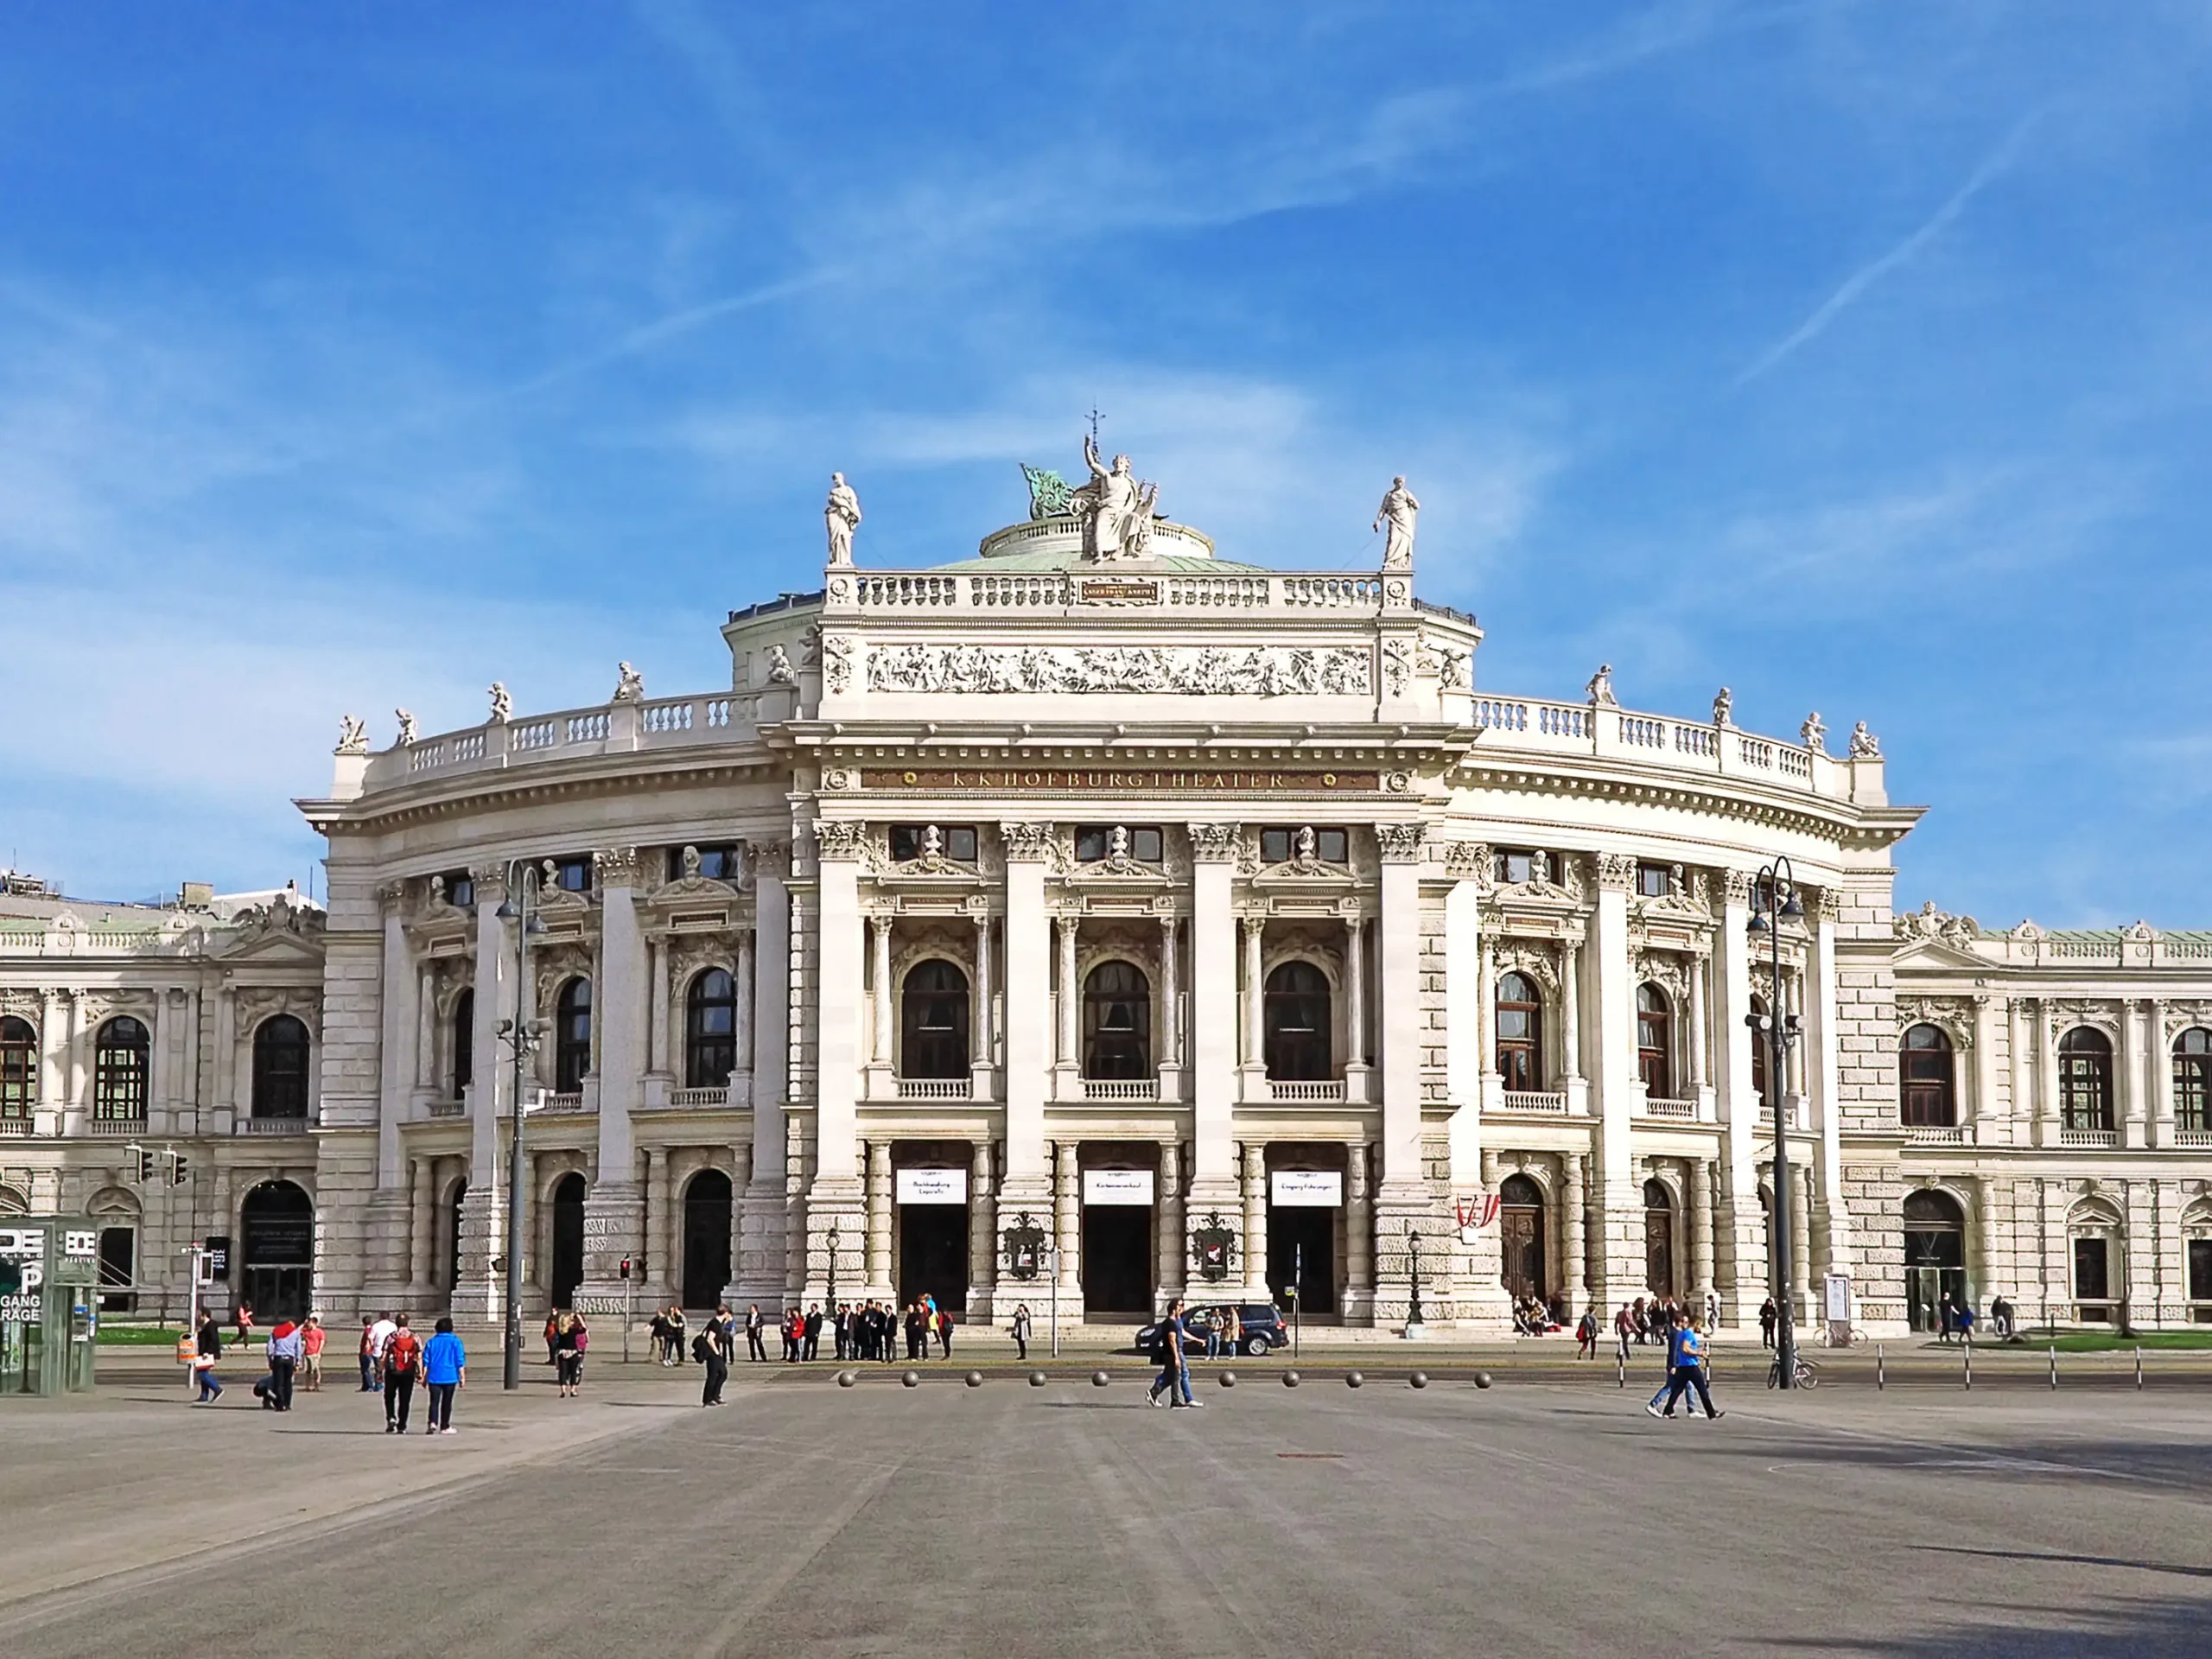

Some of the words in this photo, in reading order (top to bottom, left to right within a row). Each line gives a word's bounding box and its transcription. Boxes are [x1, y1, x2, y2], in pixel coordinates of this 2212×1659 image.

[22, 1268, 43, 1294] P
[0, 1295, 41, 1307] GANG
[0, 1309, 41, 1321] RAGE
